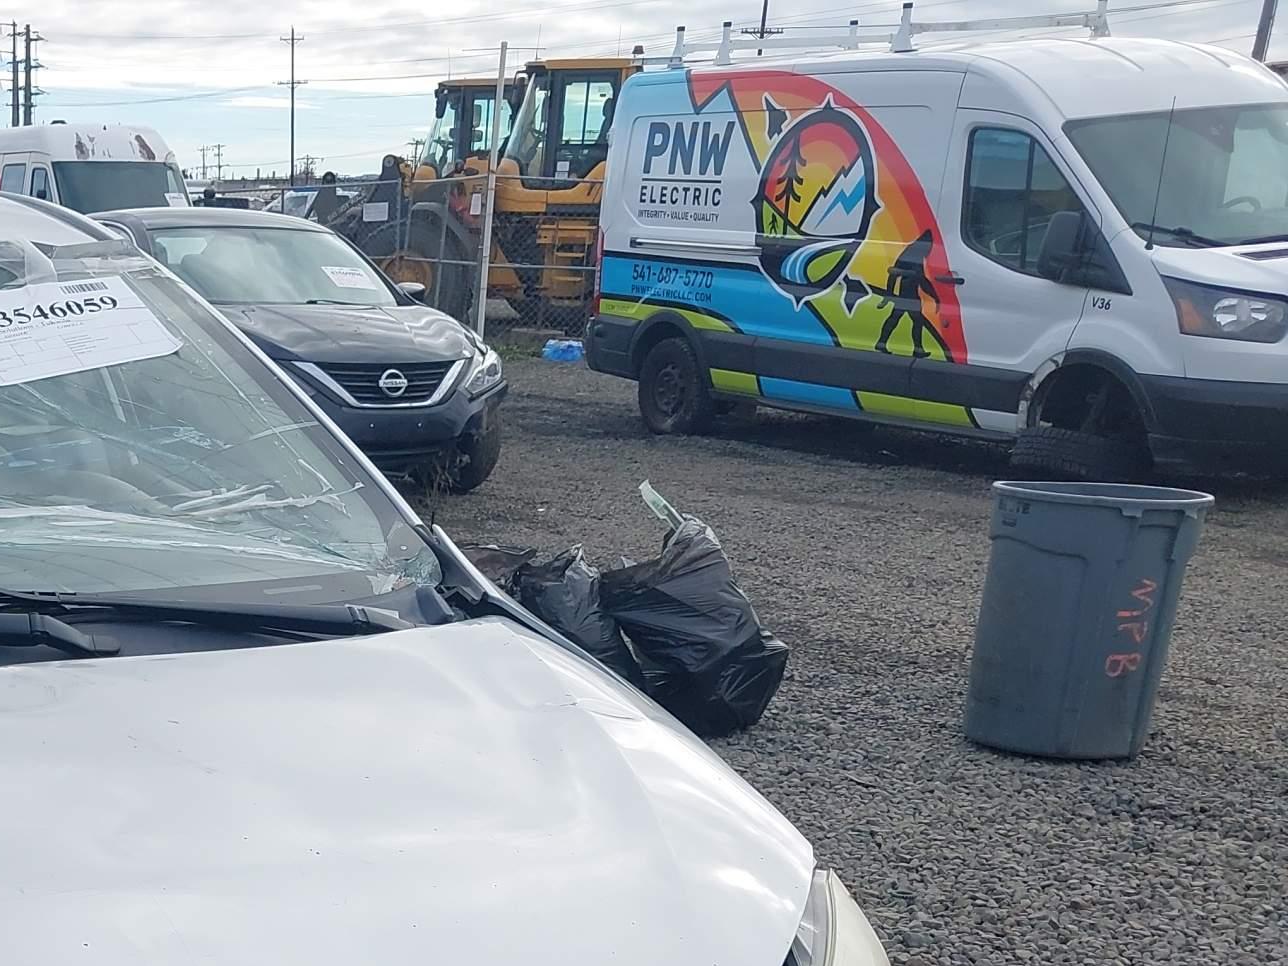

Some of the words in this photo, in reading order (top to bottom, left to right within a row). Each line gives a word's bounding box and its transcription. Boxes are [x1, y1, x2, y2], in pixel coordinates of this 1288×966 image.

[642, 121, 736, 176] PNW
[639, 185, 722, 207] ELECTRIC
[632, 263, 713, 289] 541-687-5770
[1091, 296, 1111, 311] V36
